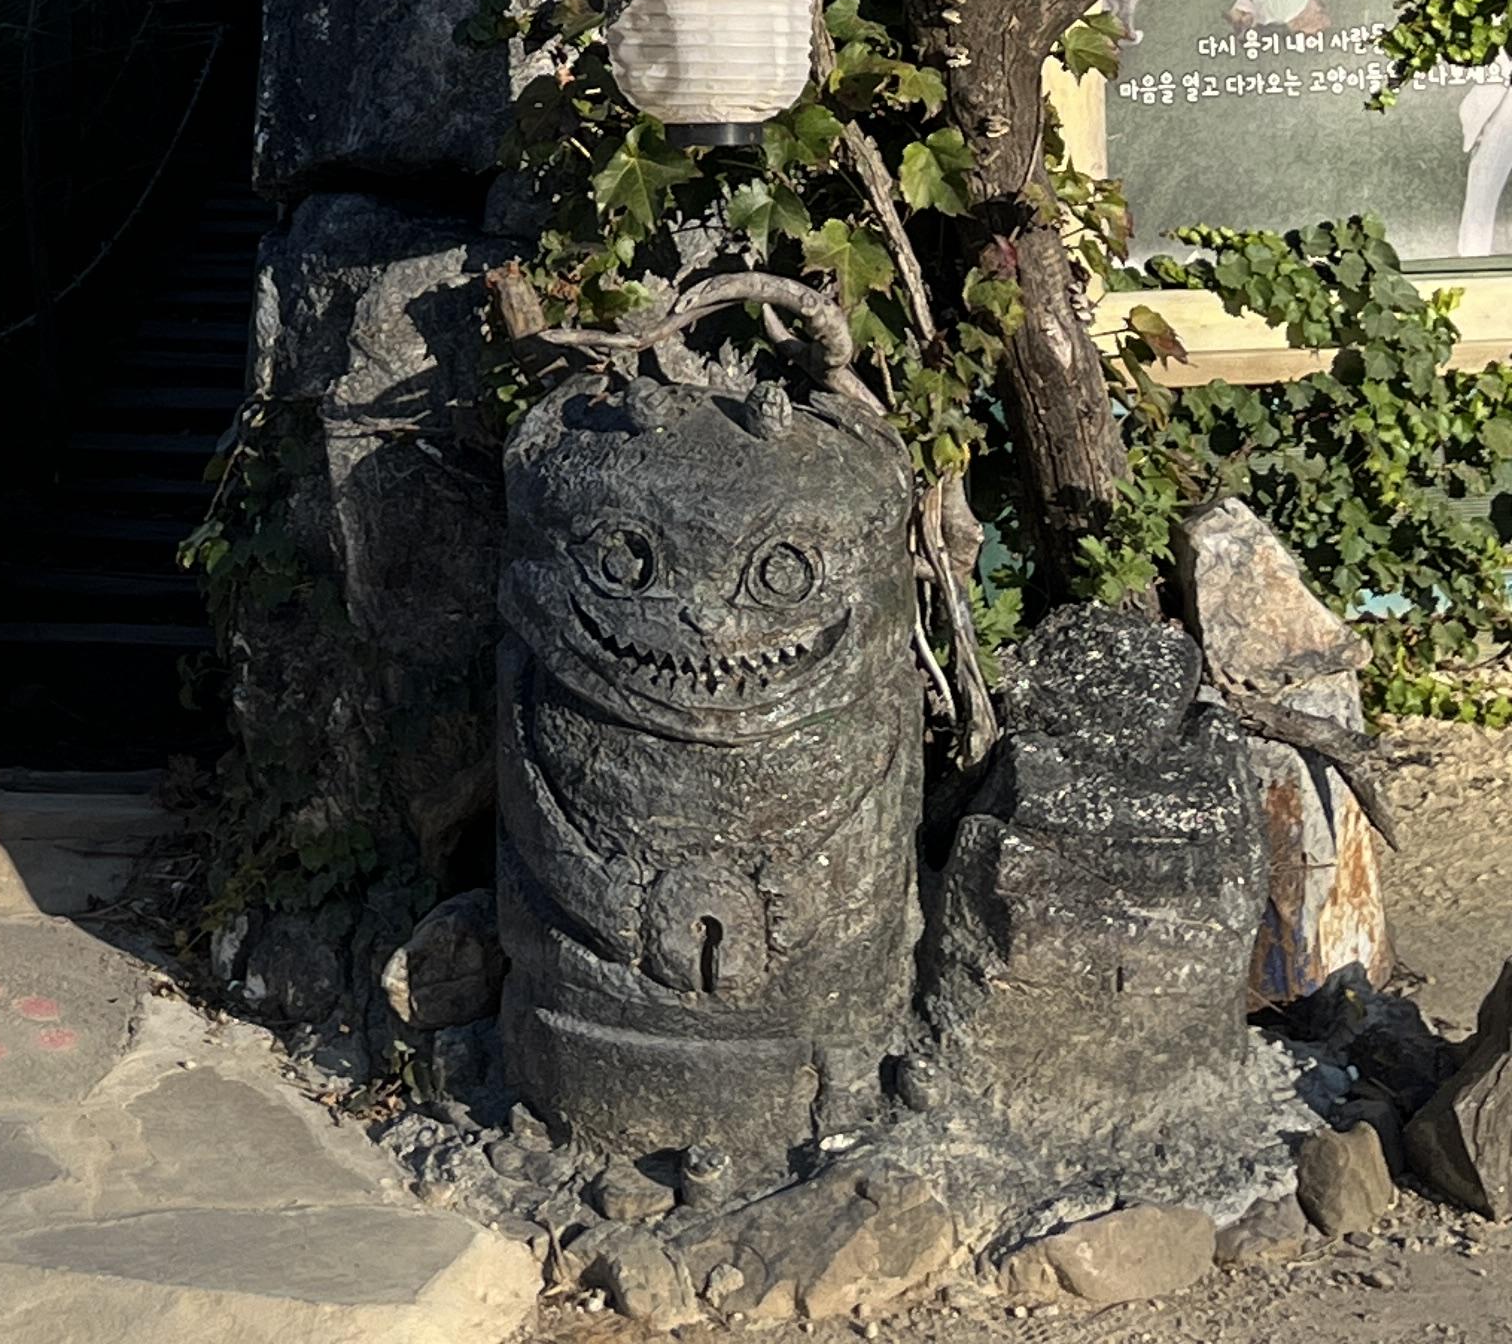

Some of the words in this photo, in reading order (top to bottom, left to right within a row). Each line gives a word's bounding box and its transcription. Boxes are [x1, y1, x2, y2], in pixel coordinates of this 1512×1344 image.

[1197, 34, 1236, 57] 다시
[1243, 29, 1280, 59] 용기
[1285, 31, 1324, 53] 내어
[1119, 71, 1177, 104] 마음을
[1181, 70, 1221, 102] 열고
[1225, 68, 1303, 97] 다가오는
